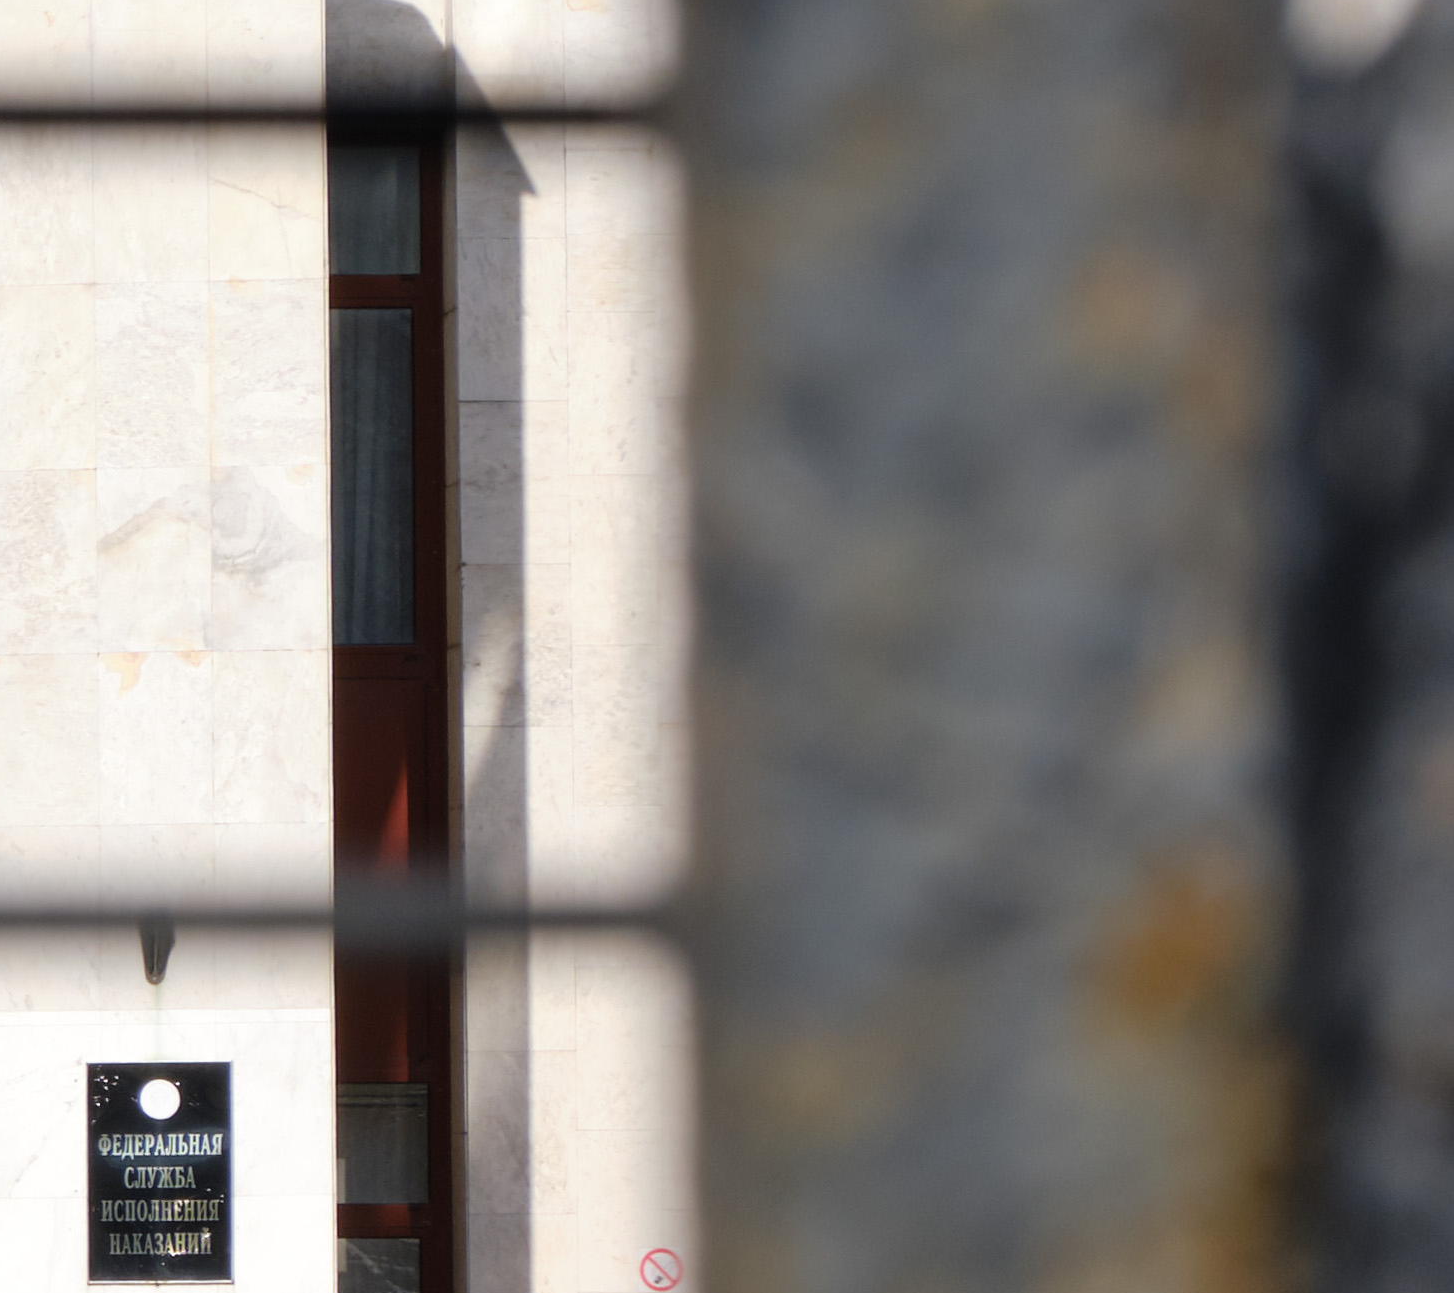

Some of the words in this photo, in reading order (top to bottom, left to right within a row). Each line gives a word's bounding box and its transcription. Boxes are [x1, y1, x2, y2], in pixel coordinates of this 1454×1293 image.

[98, 1133, 224, 1160] ФЕДЕРАЛЬНАЯ
[124, 1166, 196, 1188] СЛУЖБА
[101, 1199, 220, 1222] ИСПОЛНЕНИЯ
[109, 1228, 212, 1255] НАКАЗАНИЙ
